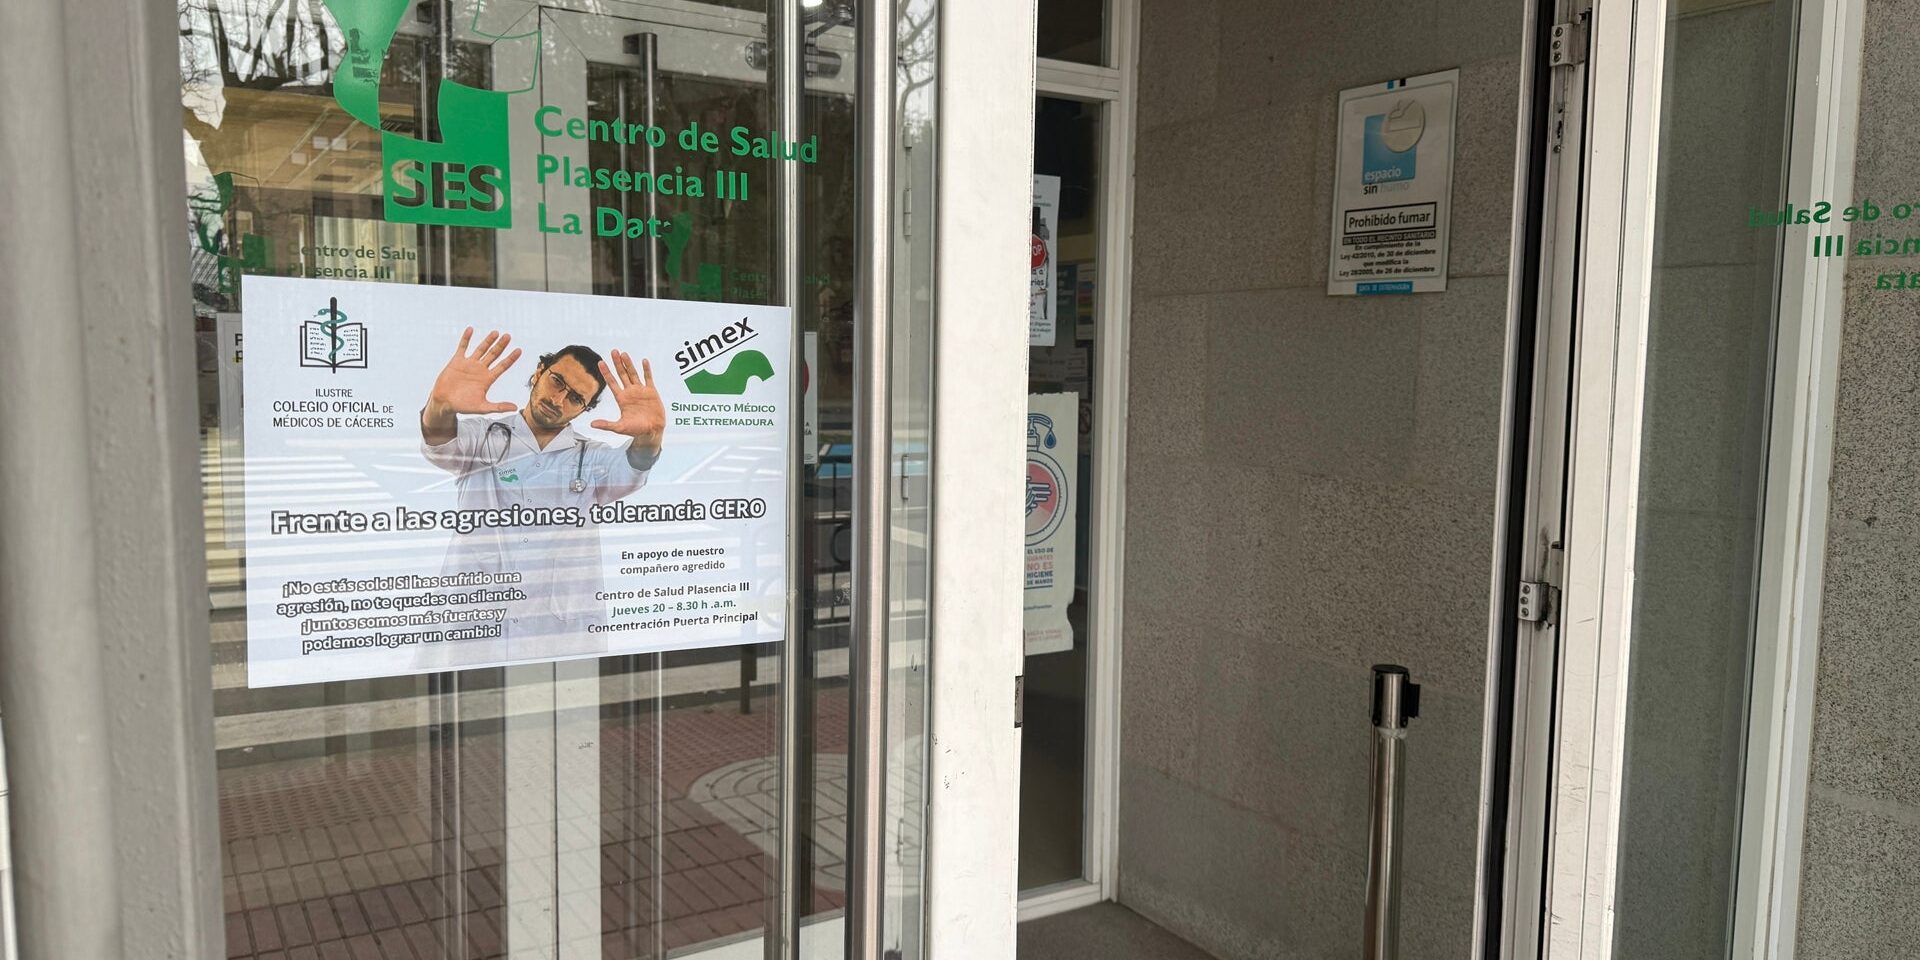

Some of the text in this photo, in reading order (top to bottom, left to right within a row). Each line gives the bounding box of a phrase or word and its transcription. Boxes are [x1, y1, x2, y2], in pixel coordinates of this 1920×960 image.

[534, 106, 818, 163] Centro de Salud
[536, 154, 748, 200] Plasencia III
[1365, 166, 1401, 181] espacio
[390, 159, 506, 213] SES
[1363, 183, 1378, 195] sin
[538, 203, 583, 235] La
[1348, 211, 1431, 229] Prohibido fumar
[355, 244, 375, 259] de
[674, 316, 755, 370] simex
[315, 388, 353, 397] ILUSTRE
[273, 401, 394, 413] COLEGIO OFICIAL DE
[671, 402, 776, 413] SINDICATO MÉDICO
[273, 414, 394, 428] MÉDICOS DE CÁCERES
[675, 416, 774, 426] DE EXTREMADURA
[271, 498, 766, 534] Frente a las agresiones, tolerancia CERO
[621, 547, 725, 561] En apoyo de nuestro
[620, 560, 725, 576] compañero agredido
[1026, 562, 1040, 571] NO
[1026, 570, 1054, 579] HIGIENE
[283, 571, 521, 598] ¡No estás solo! Si has sufrido una
[595, 582, 750, 601] Centro de Salud Plasencia III
[276, 587, 527, 617] agresión, no te quedes en silencio.
[611, 604, 650, 618] Jueves
[652, 602, 665, 613] 20
[676, 600, 699, 611] 8.30
[701, 599, 708, 610] h
[301, 608, 507, 635] ¡Juntos somos más fuertes y
[587, 611, 758, 634] Concentración Puerta Principal
[302, 624, 502, 655] podemos lograr un cambio!
